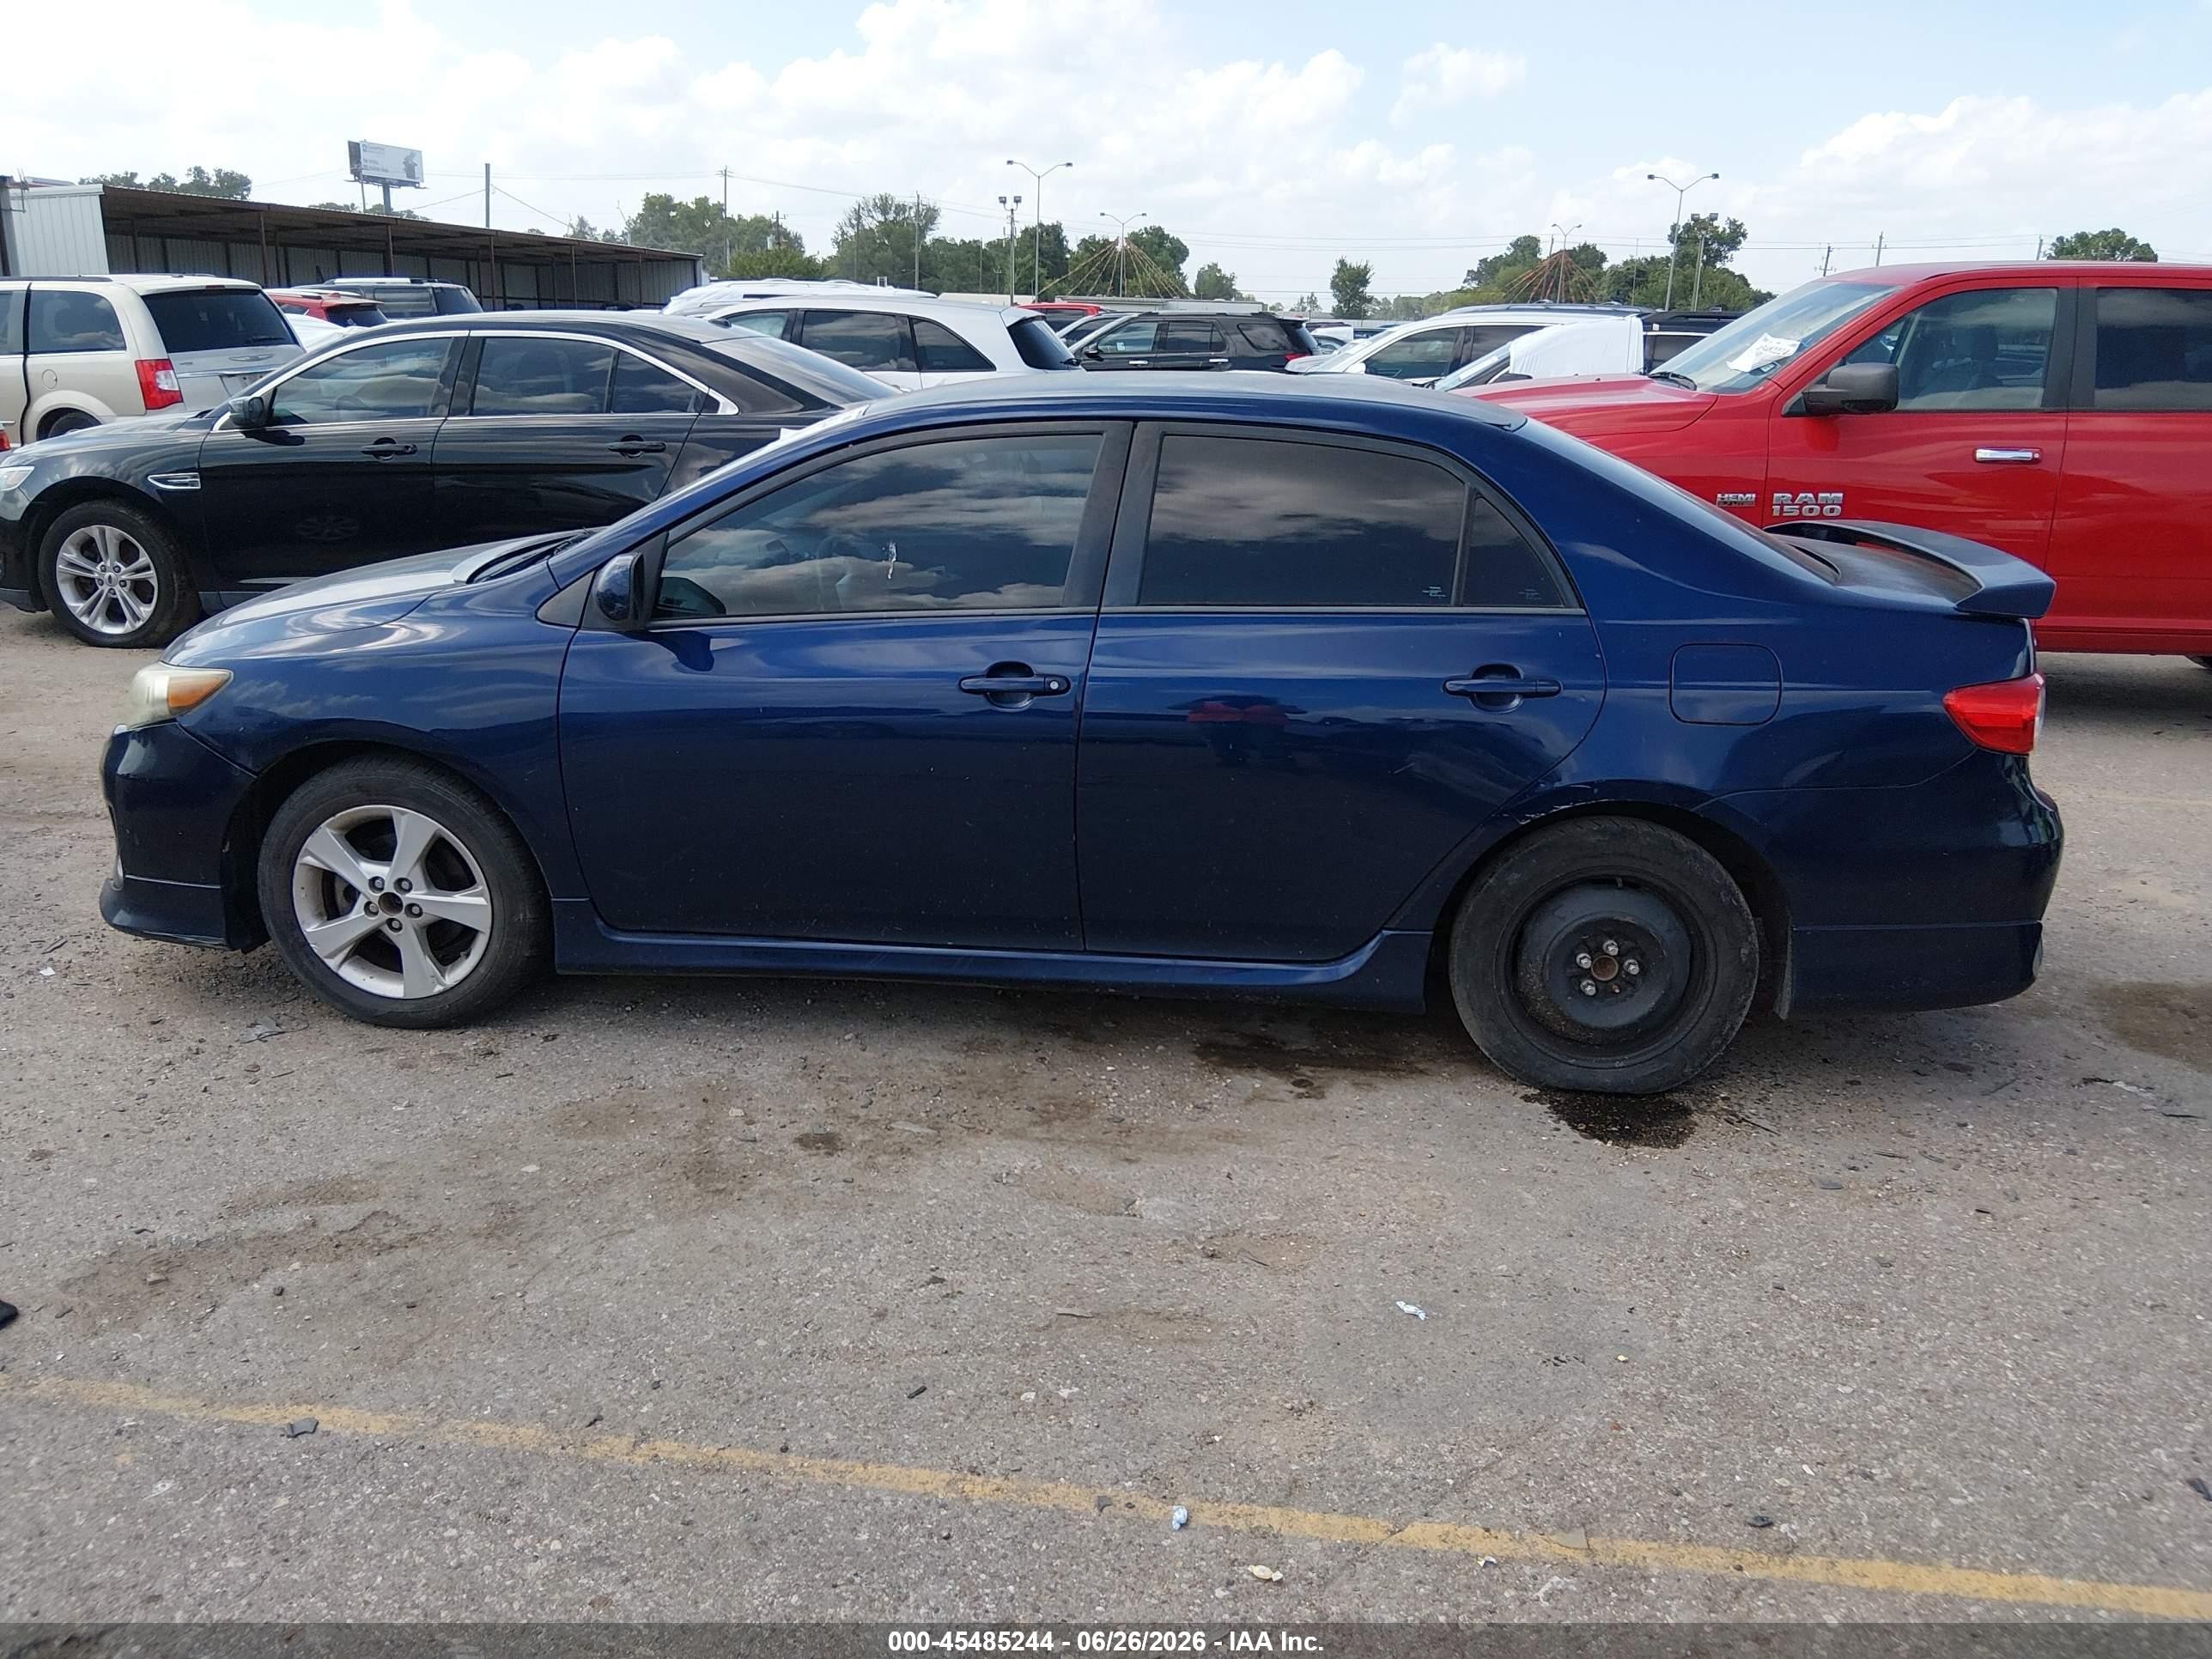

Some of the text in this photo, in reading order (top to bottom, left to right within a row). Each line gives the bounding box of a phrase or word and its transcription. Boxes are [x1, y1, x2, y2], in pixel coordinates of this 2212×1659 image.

[1717, 493, 1757, 501] HEMI
[1772, 492, 1844, 505] RAM
[1771, 505, 1842, 517] 1500
